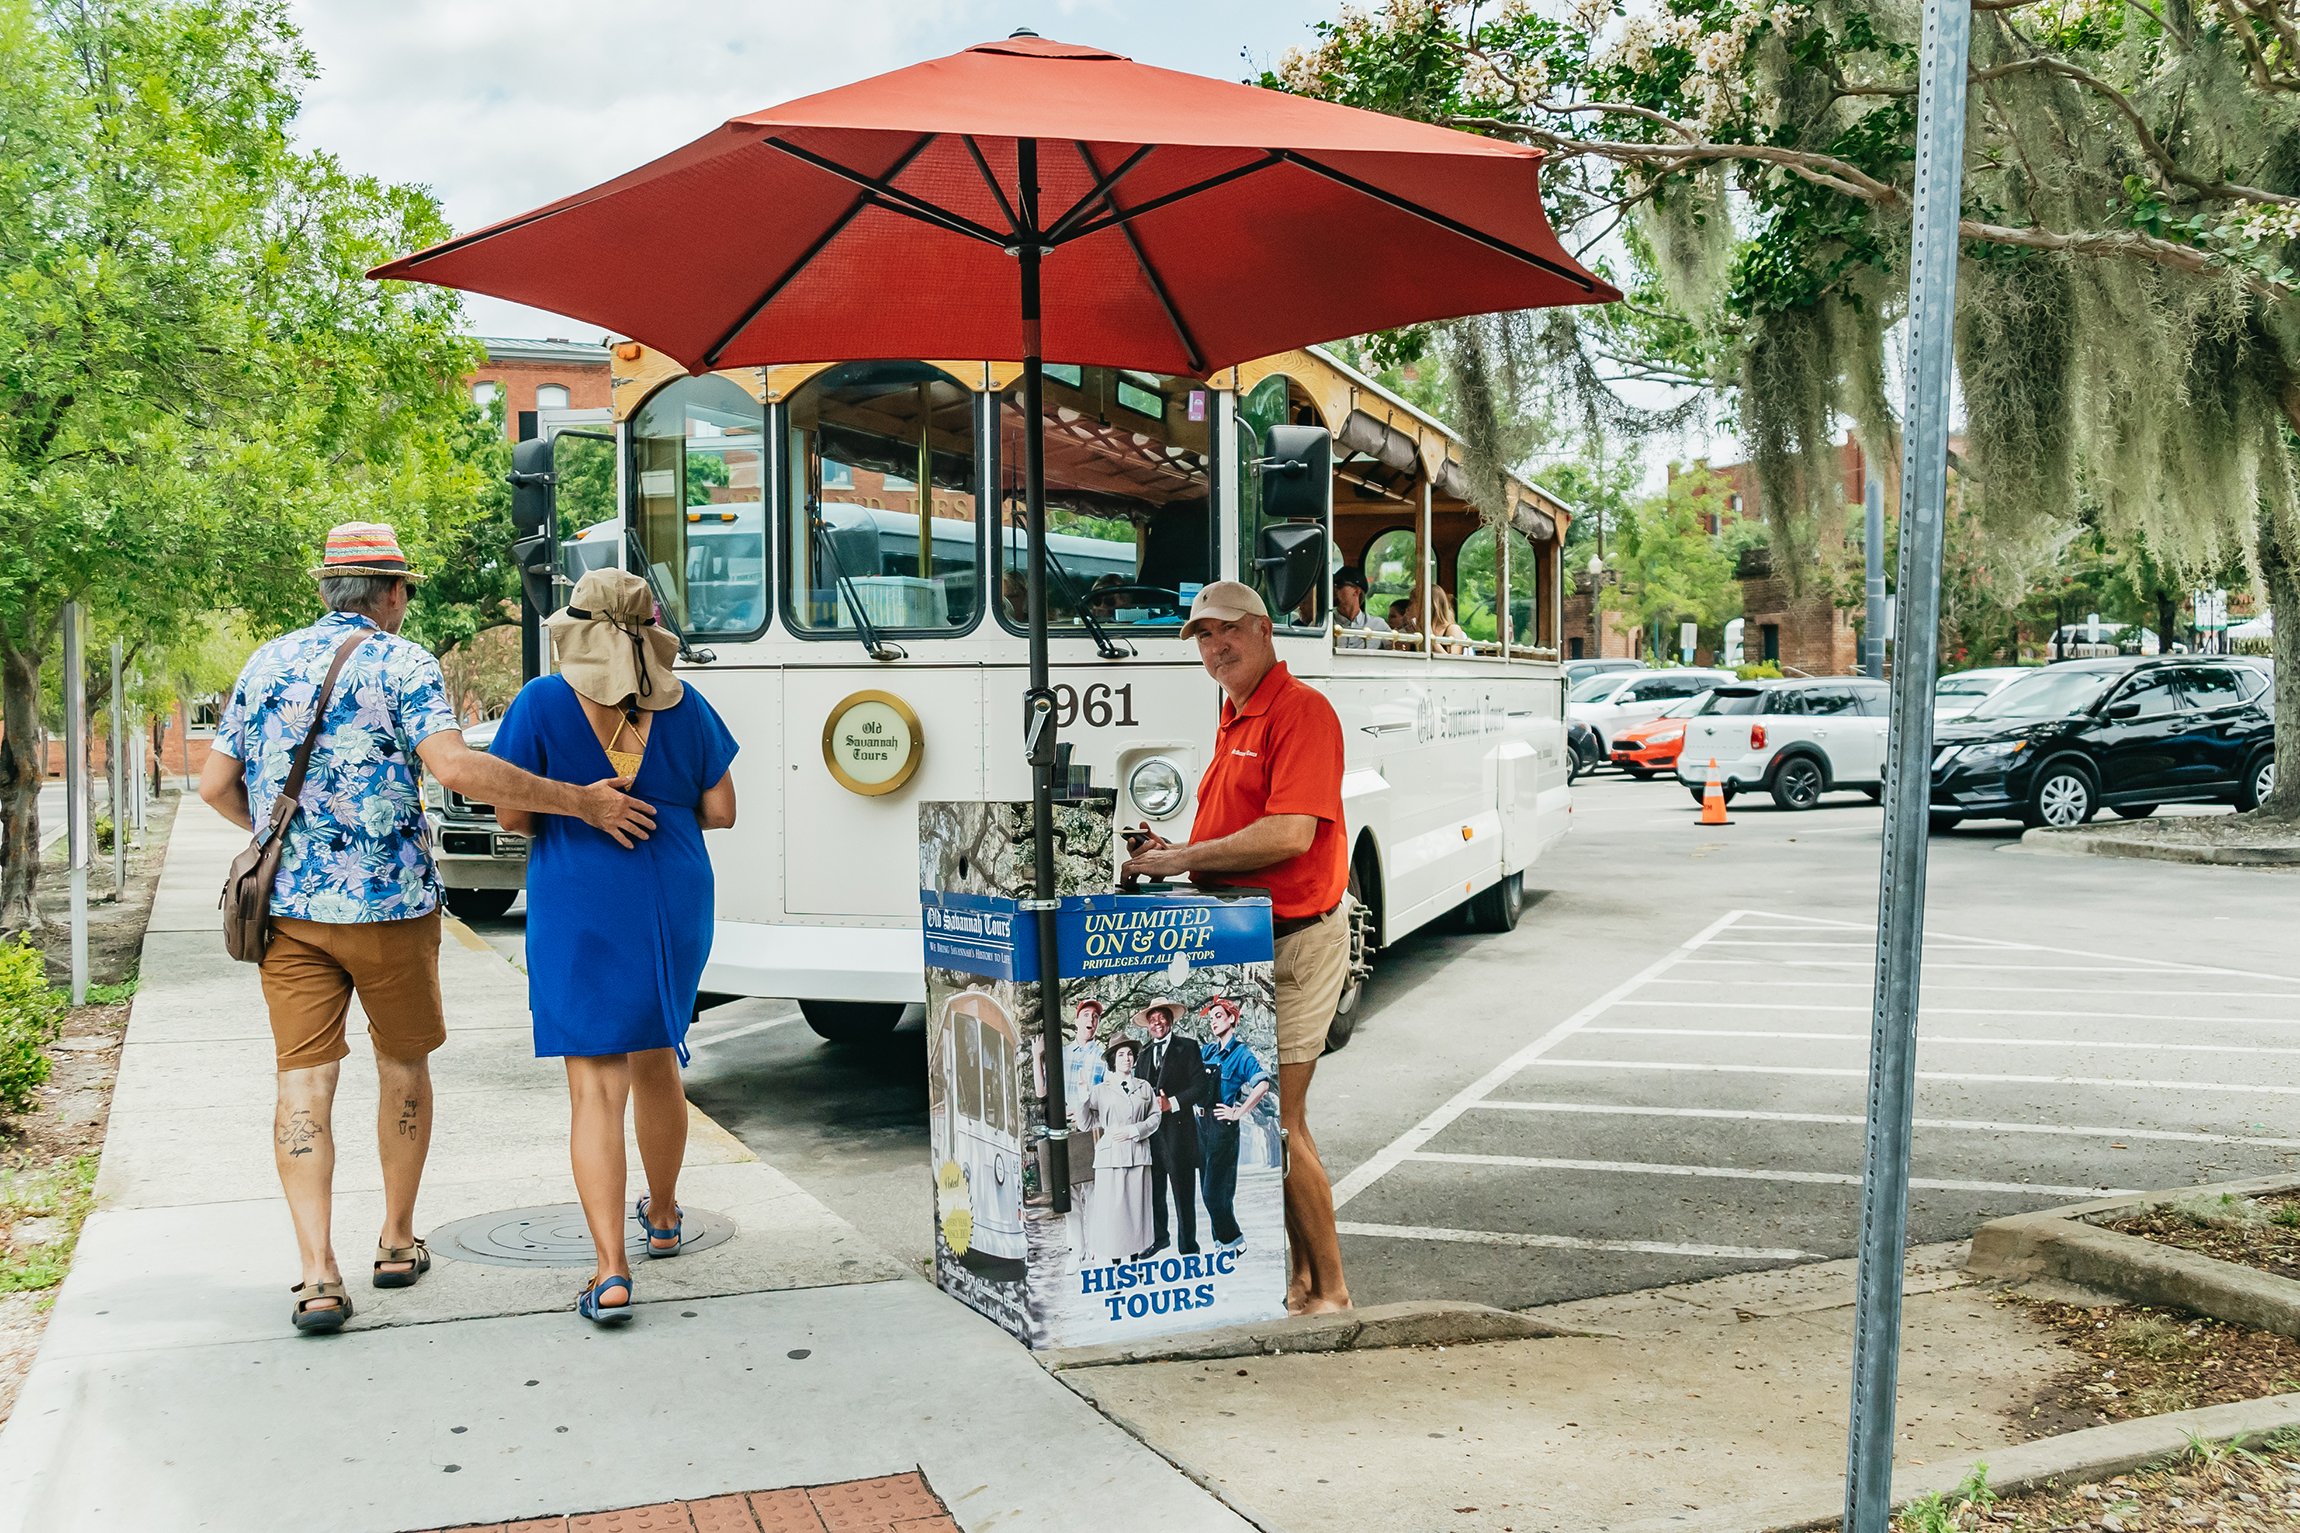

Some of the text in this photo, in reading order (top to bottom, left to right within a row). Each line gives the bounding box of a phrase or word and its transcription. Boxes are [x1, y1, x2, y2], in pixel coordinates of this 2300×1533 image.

[1051, 683, 1139, 727] 961
[862, 721, 882, 734] Old
[845, 734, 898, 751] Savannah
[852, 748, 888, 761] Tours
[927, 907, 1011, 938] Old Savannah Tours
[1085, 907, 1211, 933] UNLIMITED
[1085, 926, 1214, 957] ON & OFF
[1082, 949, 1215, 970] PRIVILEGES AT ALL STOPS
[1080, 1249, 1236, 1295] HISTORIC
[1104, 1283, 1216, 1321] TOURS
